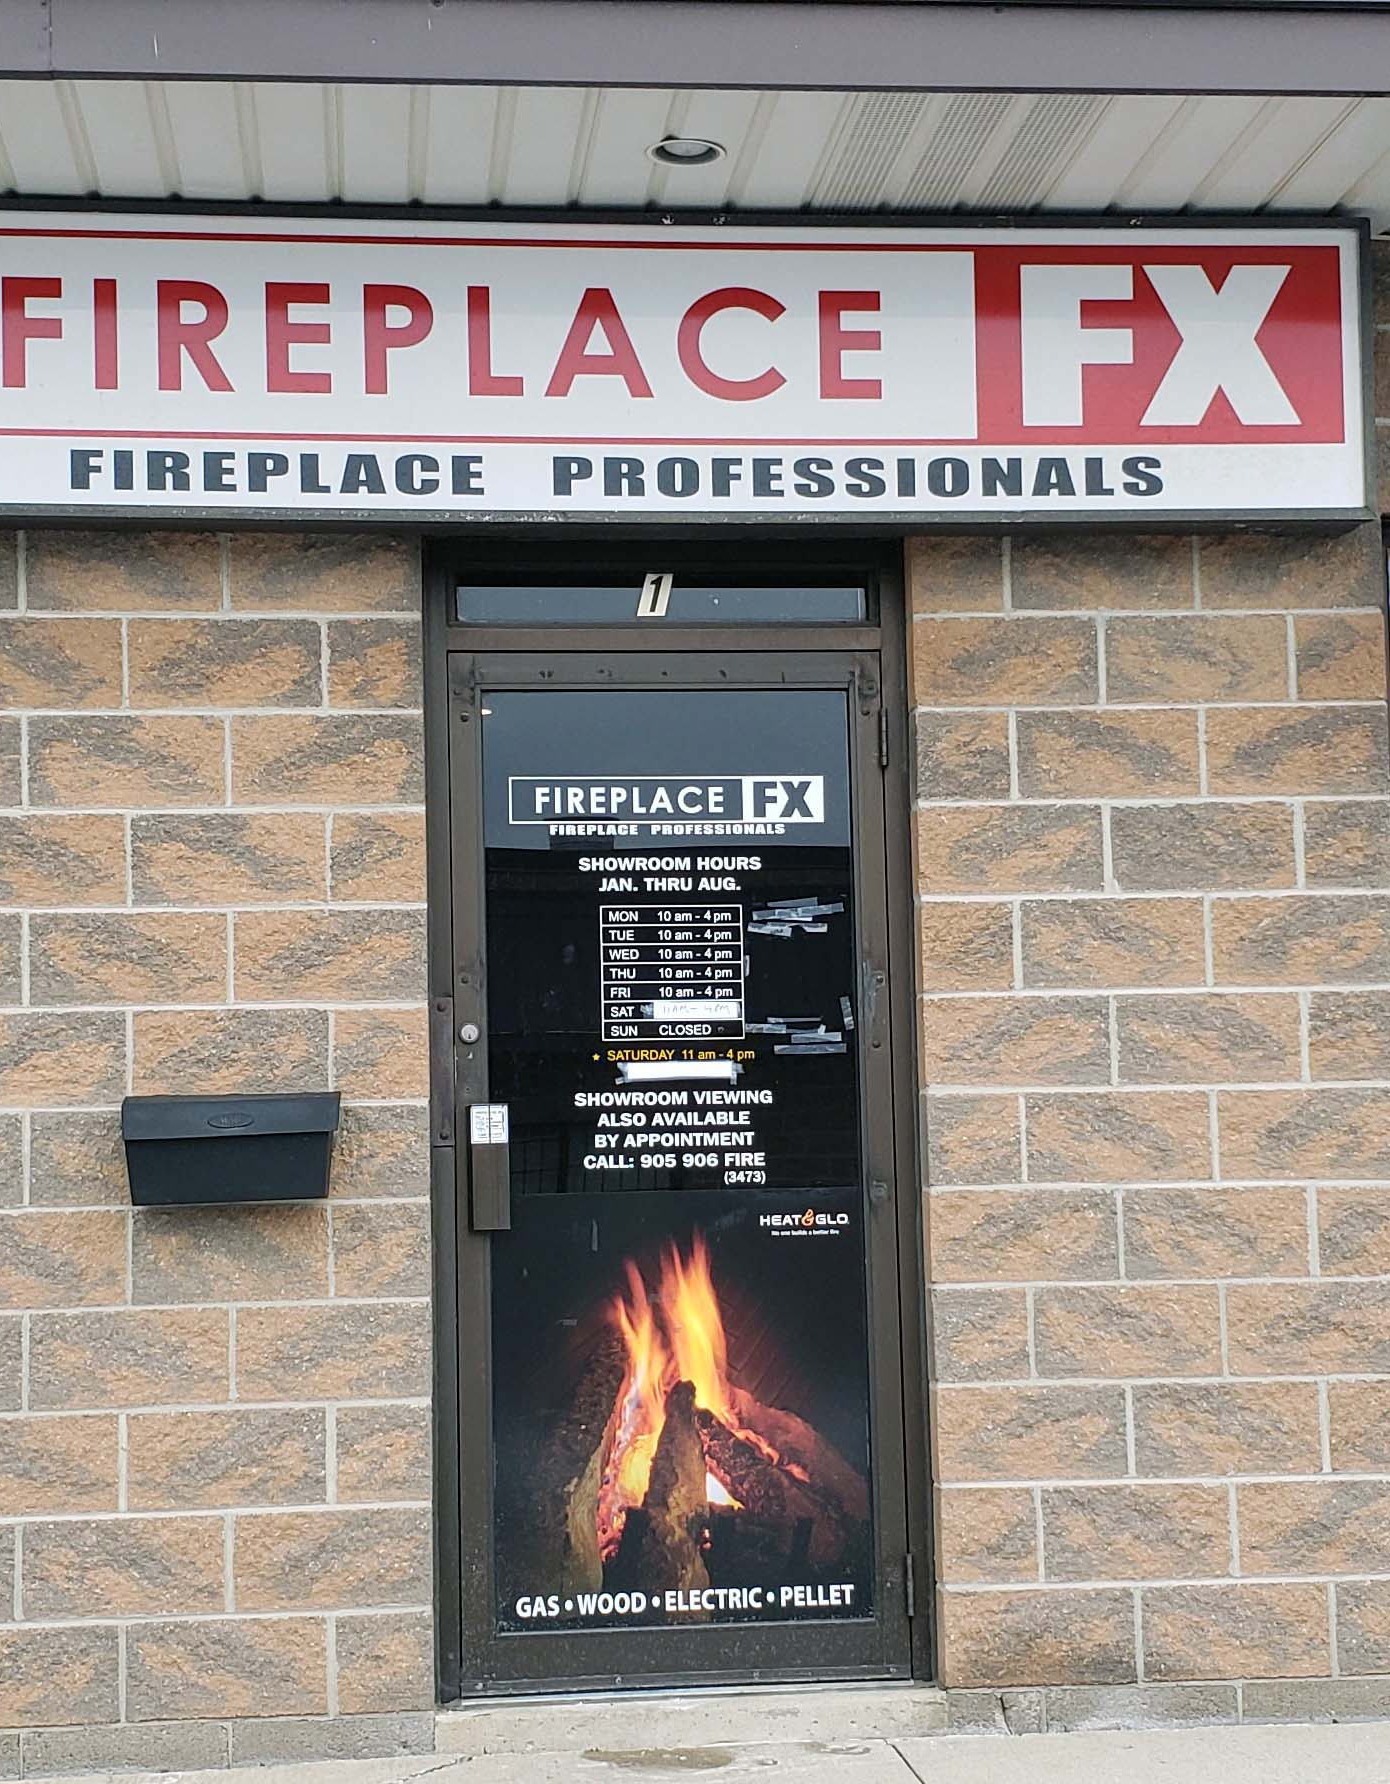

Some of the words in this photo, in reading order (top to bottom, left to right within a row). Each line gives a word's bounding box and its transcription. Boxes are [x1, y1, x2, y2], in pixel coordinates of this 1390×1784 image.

[0, 275, 883, 400] FIREPLACE
[1017, 264, 1302, 427] FX
[68, 449, 487, 496] FIREPLACE
[553, 453, 1167, 499] PROFESSIONALS
[650, 576, 664, 612] 1
[534, 786, 724, 814] FIREPLACE
[753, 781, 814, 818] FX
[549, 824, 638, 836] FIREPLACE
[651, 823, 785, 835] PROFESSIONALS
[578, 857, 691, 872] SHOWROOM
[697, 856, 762, 871] HOURS
[598, 878, 639, 892] JAN.
[643, 877, 693, 892] THRU
[698, 877, 741, 891] AUG.
[608, 911, 639, 922] MON
[657, 911, 671, 922] 10
[674, 912, 693, 922] am
[703, 910, 712, 921] 4
[713, 912, 732, 923] pm
[609, 930, 635, 941] TUE
[657, 930, 672, 941] 10
[674, 931, 693, 941] am
[703, 929, 712, 940] 4
[713, 931, 732, 943] pm
[609, 949, 640, 960] WED
[658, 949, 672, 960] 10
[674, 950, 693, 960] am
[704, 948, 712, 959] 4
[714, 950, 733, 962] pm
[609, 968, 637, 979] THU
[658, 968, 672, 979] 10
[675, 969, 694, 979] am
[704, 967, 713, 978] 4
[714, 969, 733, 980] pm
[610, 987, 631, 998] FRI
[658, 987, 673, 998] 10
[675, 988, 694, 997] am
[704, 986, 713, 997] 4
[714, 988, 733, 999] pm
[610, 1006, 635, 1018] SAT
[610, 1025, 638, 1037] SUN
[658, 1024, 712, 1036] CLOSED
[606, 1049, 675, 1061] SATURDAY
[681, 1049, 694, 1060] 11
[697, 1050, 716, 1060] am
[726, 1048, 734, 1060] 4
[736, 1050, 755, 1062] pm
[574, 1091, 687, 1107] SHOWROOM
[693, 1090, 773, 1105] VIEWING
[597, 1112, 647, 1127] ALSO
[651, 1111, 751, 1126] AVAILABLE
[594, 1134, 620, 1148] BY
[623, 1131, 755, 1148] APPOINTMENT
[583, 1154, 635, 1169] CALL:
[640, 1153, 677, 1168] 905
[682, 1152, 719, 1168] 906
[724, 1152, 766, 1167] FIRE
[723, 1171, 766, 1185] (3473)
[759, 1208, 849, 1227] HEAT&GLO
[515, 1595, 560, 1618] GAS
[577, 1591, 647, 1616] WOOD
[664, 1586, 763, 1612] ELECTRIC
[780, 1583, 855, 1608] PELLET
